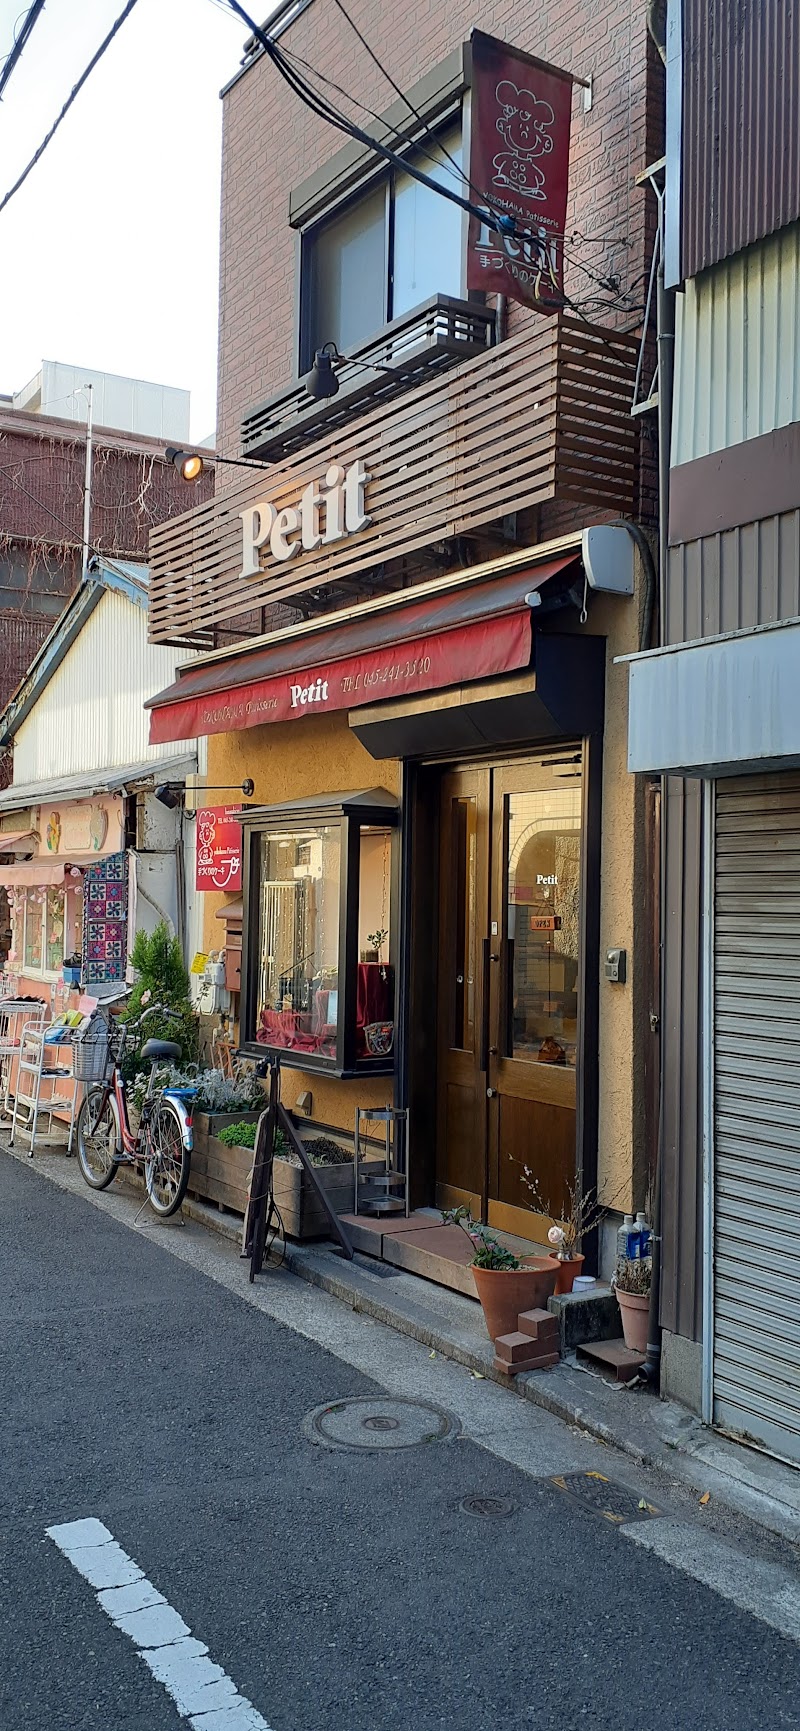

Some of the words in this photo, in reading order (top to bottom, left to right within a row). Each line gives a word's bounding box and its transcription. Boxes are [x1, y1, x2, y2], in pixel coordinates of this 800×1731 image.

[238, 460, 372, 579] Petit
[290, 678, 329, 708] Petit
[536, 874, 558, 884] Petit
